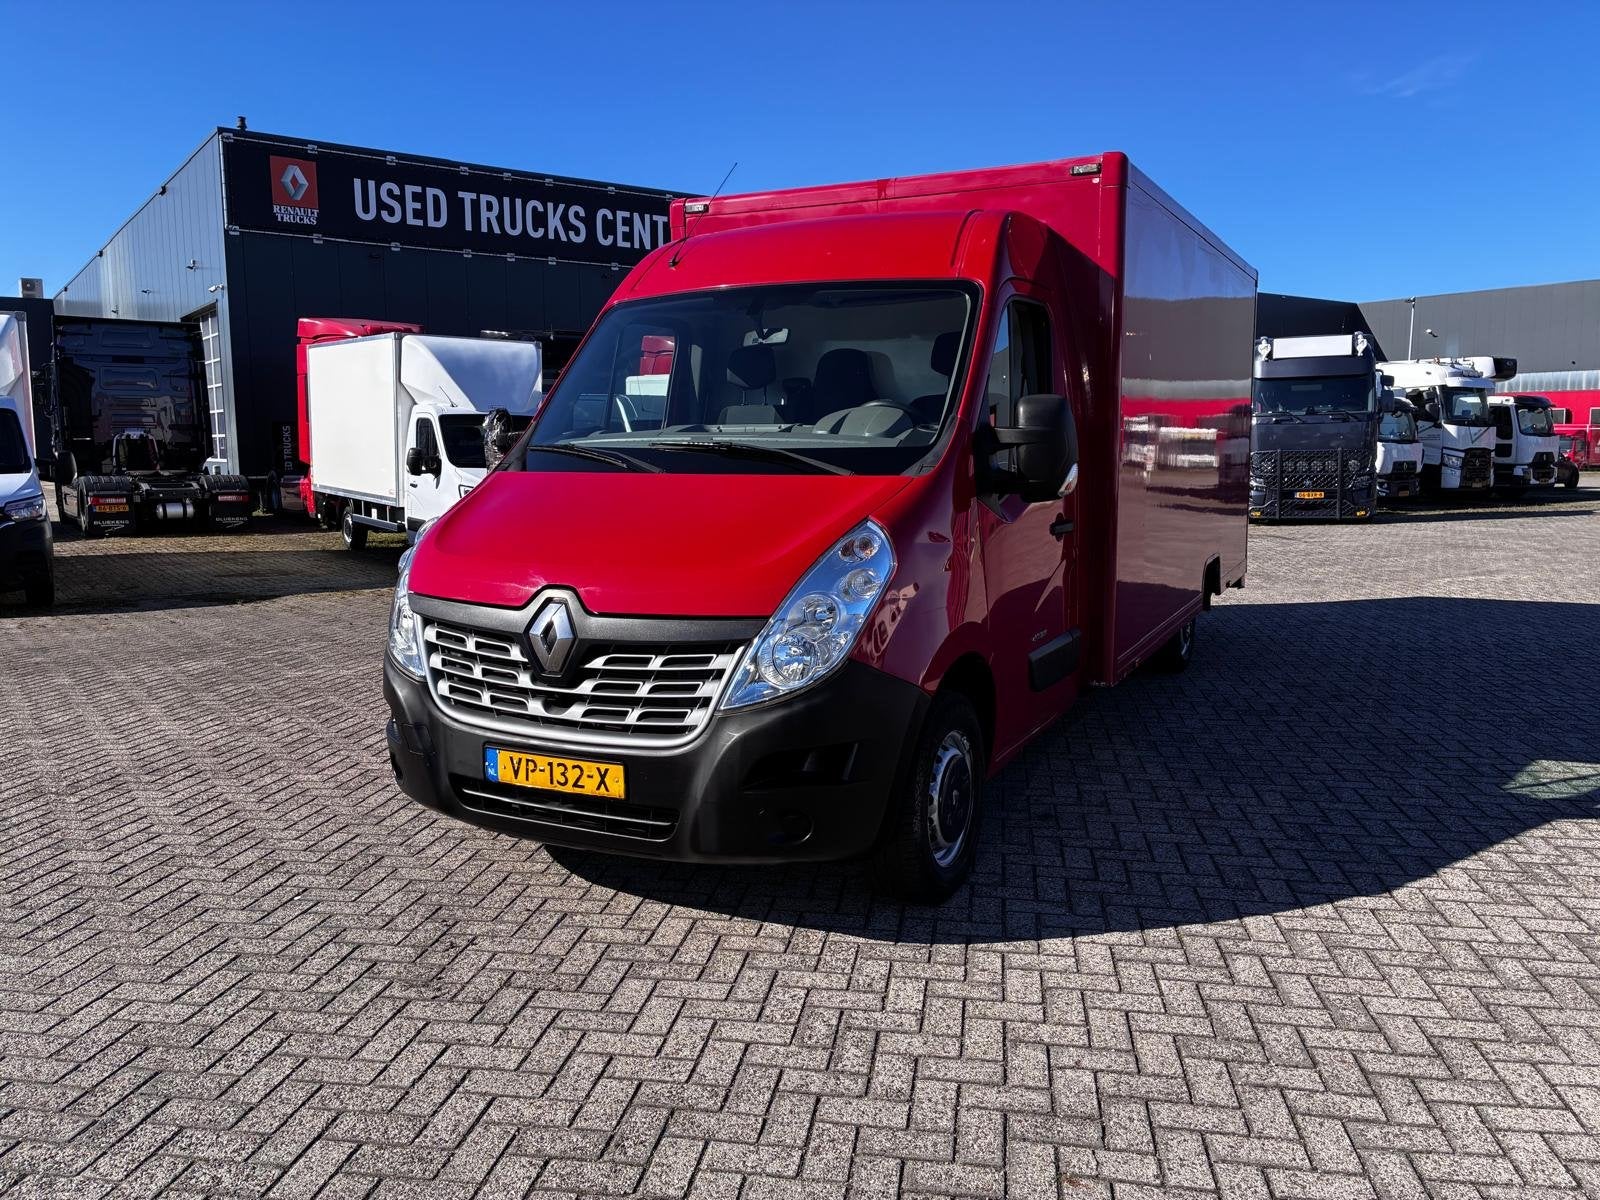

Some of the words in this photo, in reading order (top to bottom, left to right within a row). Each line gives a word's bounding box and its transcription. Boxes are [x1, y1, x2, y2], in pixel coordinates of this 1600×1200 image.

[273, 204, 319, 217] RENAULT
[276, 213, 317, 225] TRUCKS
[353, 177, 448, 228] USED
[457, 190, 587, 244] TRUCKS
[596, 208, 669, 250] CENT
[282, 425, 291, 460] TRUCKS
[488, 768, 497, 776] NL
[509, 756, 610, 792] VP-132-X
